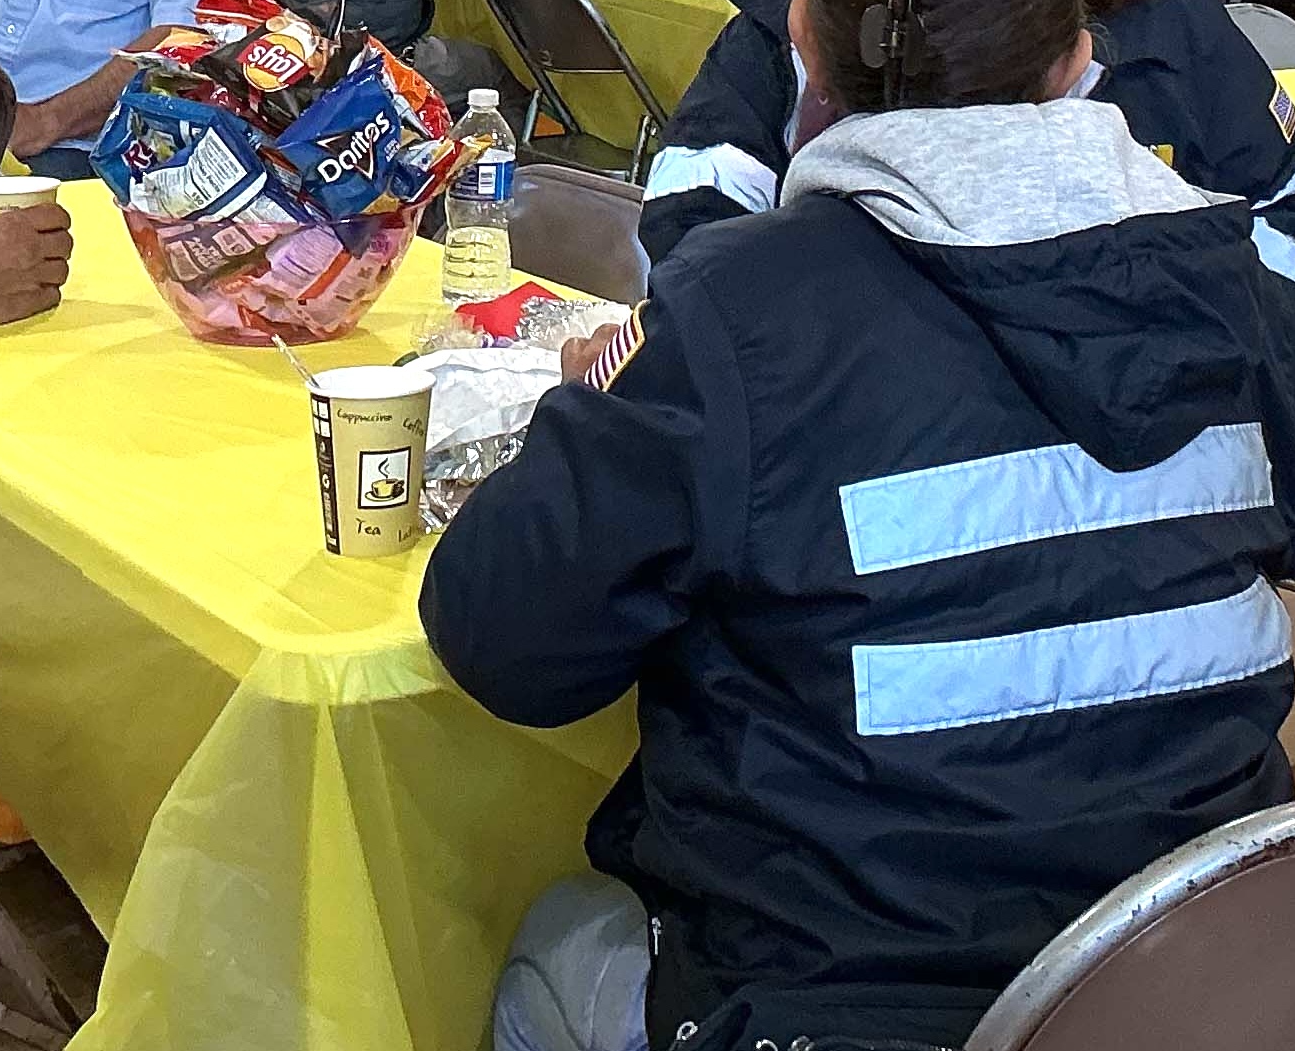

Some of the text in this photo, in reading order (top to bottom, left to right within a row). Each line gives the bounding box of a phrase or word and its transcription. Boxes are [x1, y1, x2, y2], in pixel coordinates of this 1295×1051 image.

[316, 111, 390, 183] Doritos
[337, 408, 393, 425] Cappuccino
[356, 517, 382, 536] Tea
